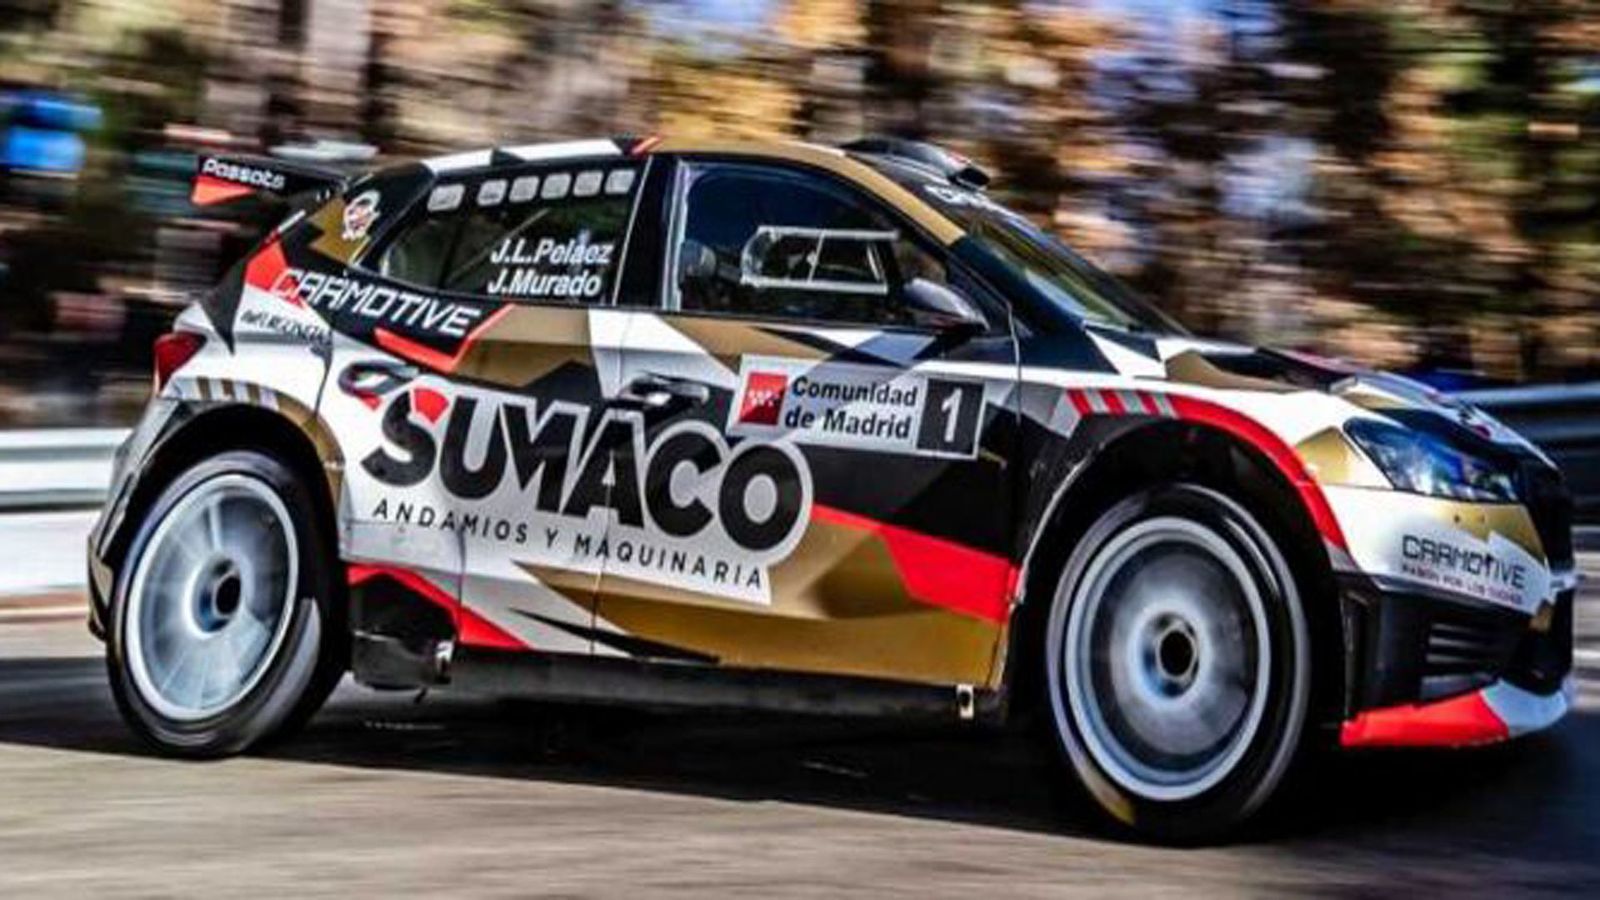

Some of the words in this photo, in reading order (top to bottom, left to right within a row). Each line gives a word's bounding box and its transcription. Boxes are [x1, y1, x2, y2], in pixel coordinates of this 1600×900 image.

[270, 268, 481, 338] CARMOTIVE
[487, 267, 602, 297] J.Murado
[791, 375, 919, 408] Comunidad
[941, 386, 964, 444] 1
[784, 405, 815, 429] de
[822, 409, 912, 439] Madrid
[360, 386, 802, 551] SUMACO
[373, 500, 529, 545] ANDAMIOS
[545, 528, 560, 547] Y
[574, 535, 763, 590] MAQUINARIA
[1402, 534, 1526, 590] CARMOTIVE
